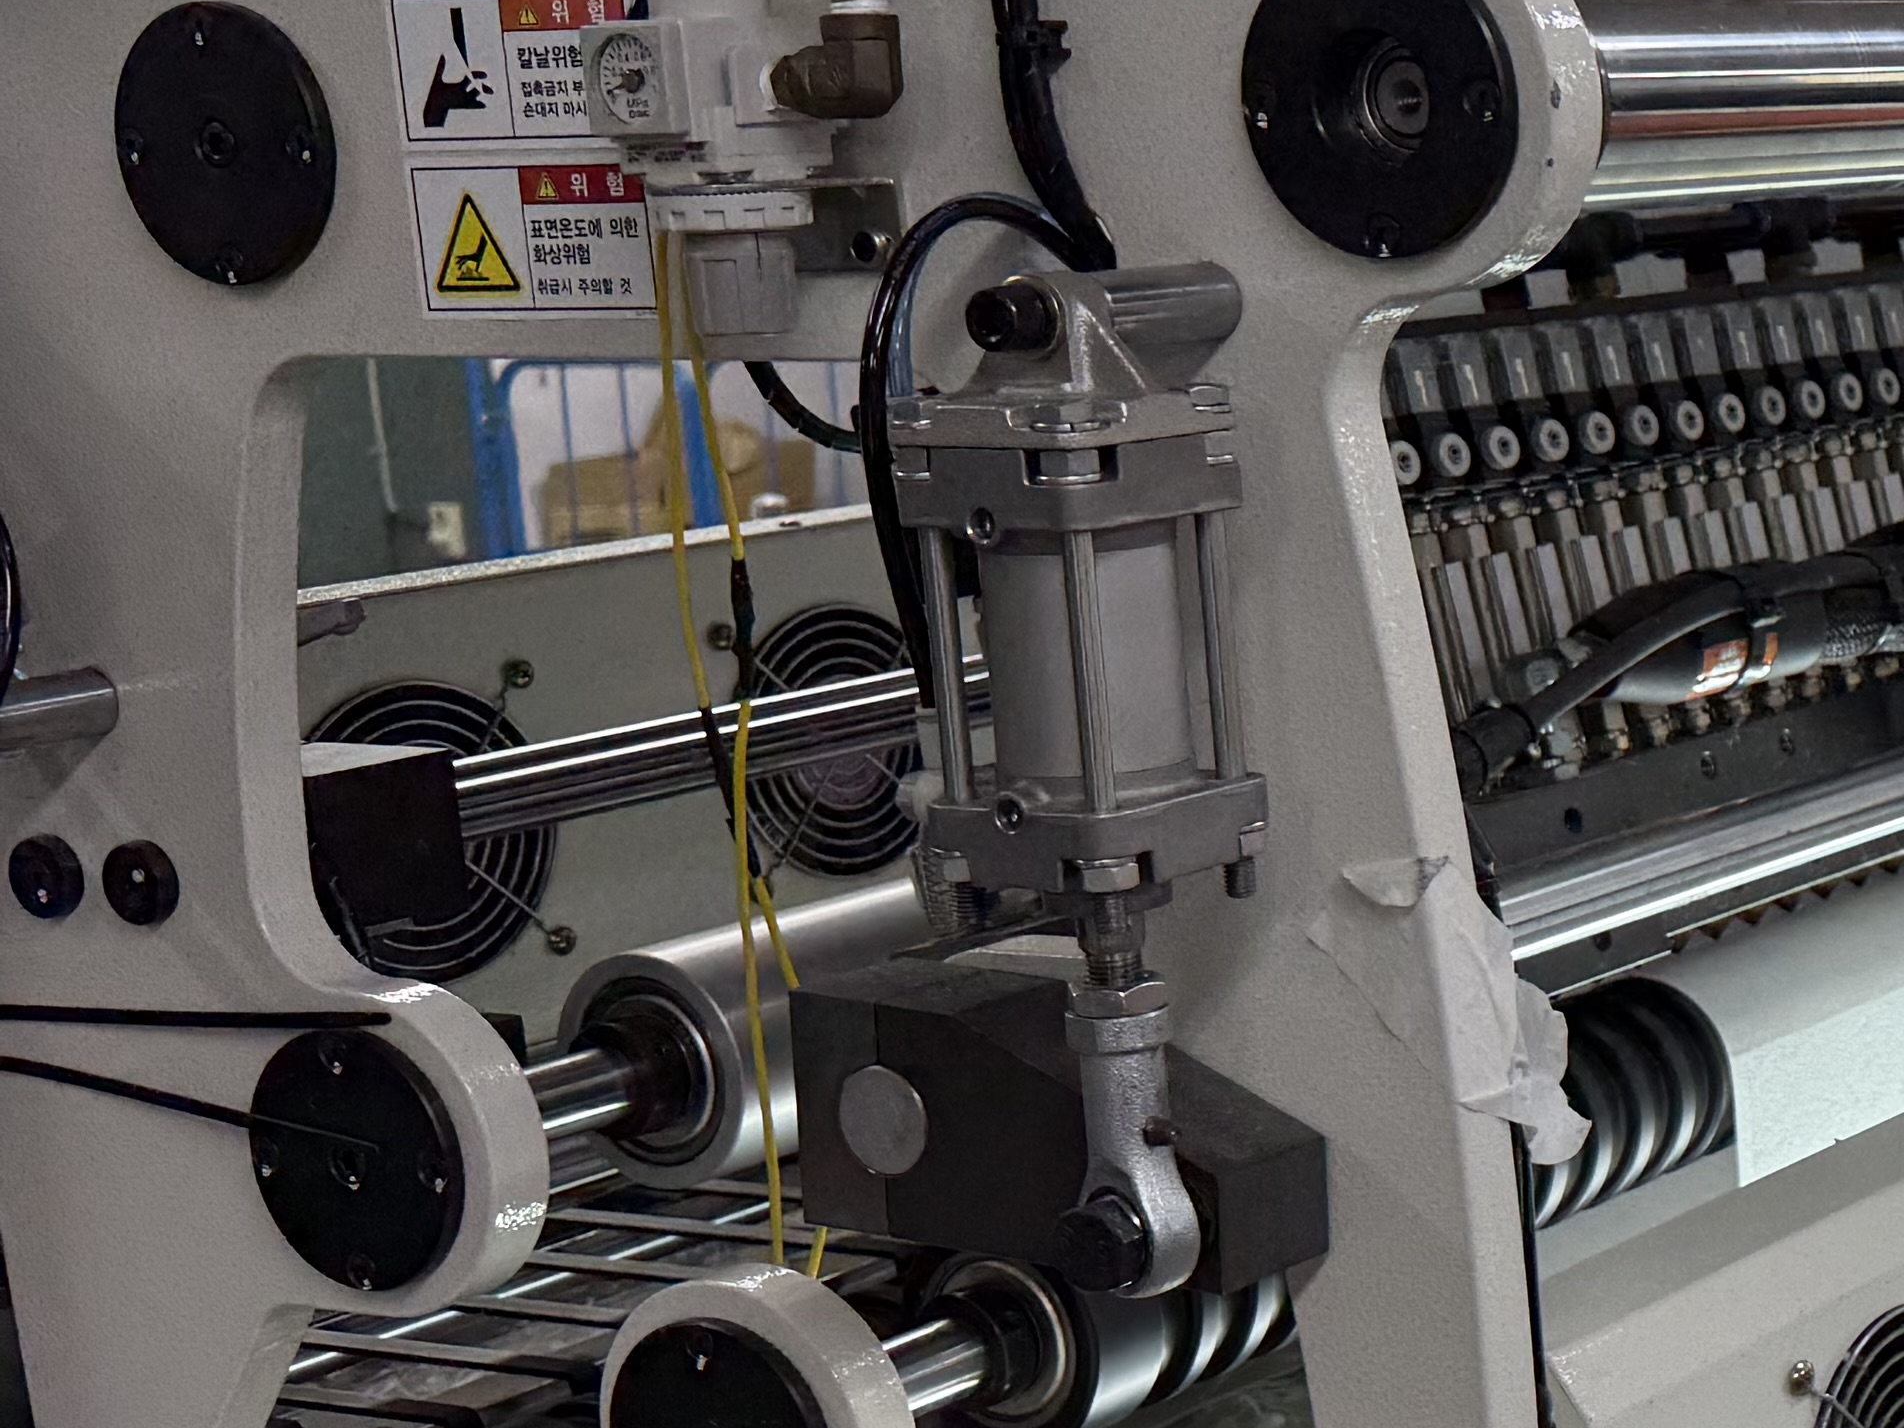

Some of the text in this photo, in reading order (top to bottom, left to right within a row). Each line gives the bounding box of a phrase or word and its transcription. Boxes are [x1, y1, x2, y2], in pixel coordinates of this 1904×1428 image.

[552, 0, 569, 24] 위
[523, 102, 560, 118] 손대지
[570, 172, 624, 197] 위 험
[530, 218, 639, 240] 표면온도에 의한
[533, 244, 592, 265] 화상위험
[620, 278, 633, 295] 것
